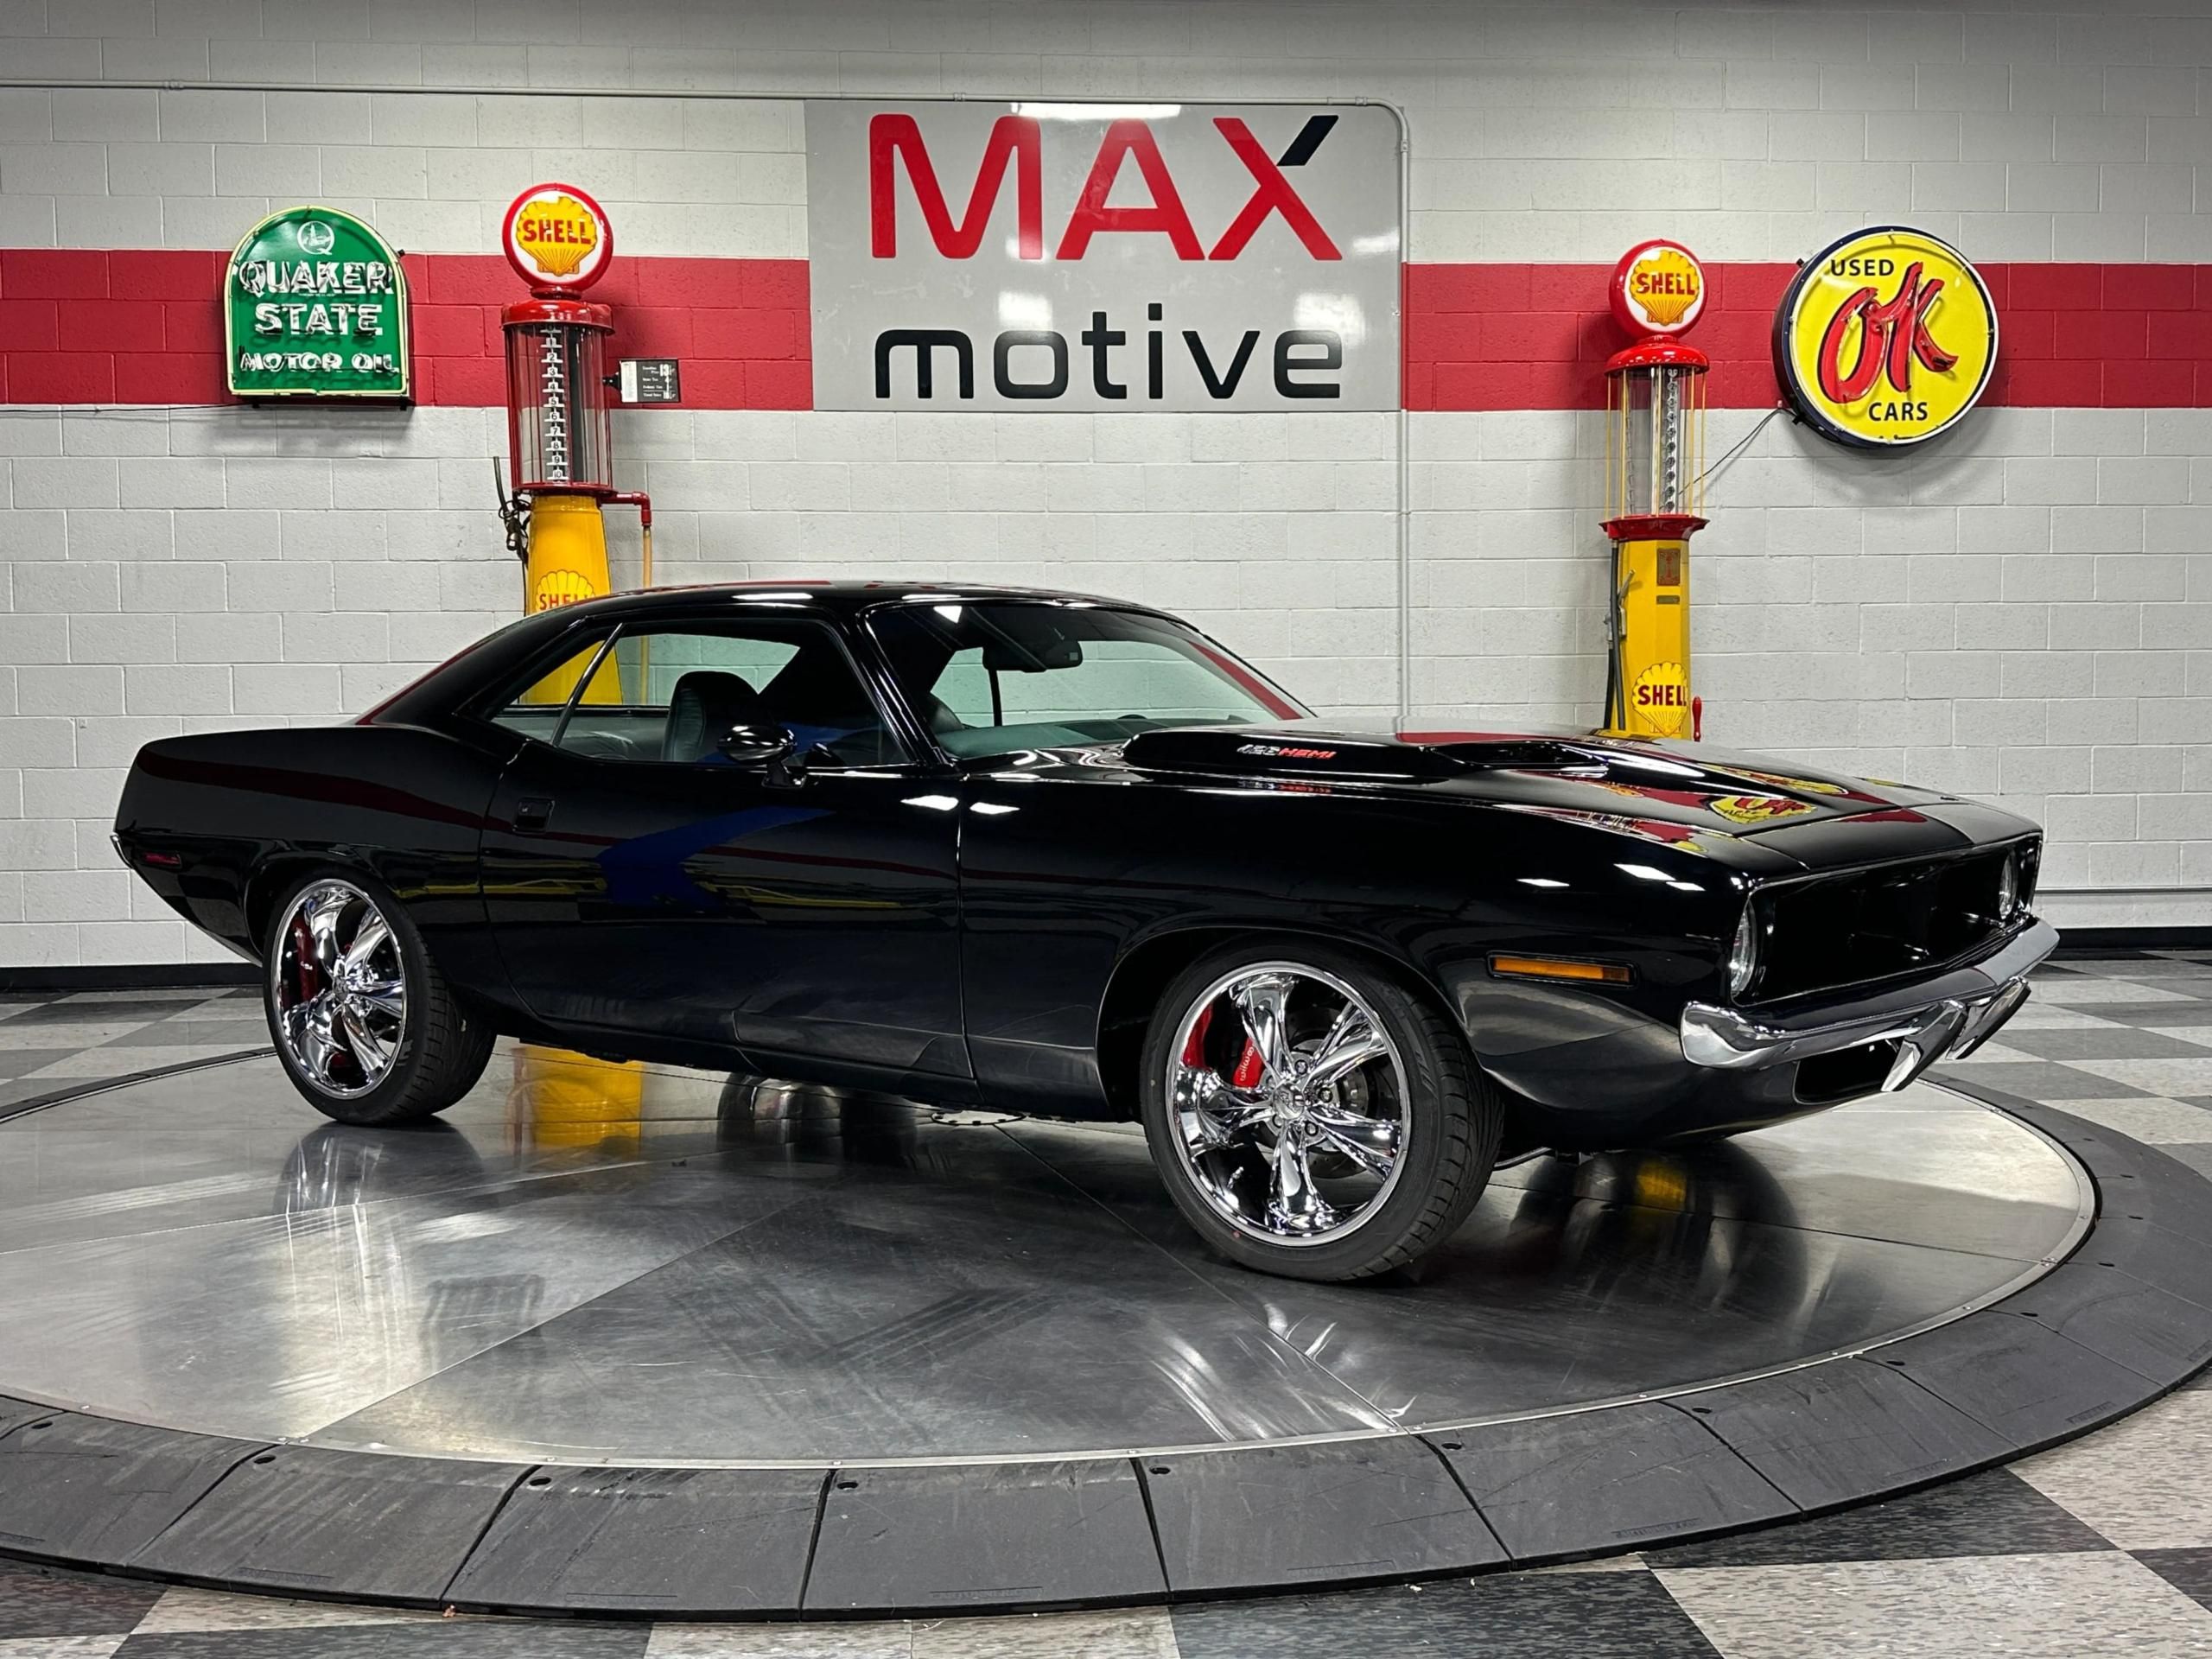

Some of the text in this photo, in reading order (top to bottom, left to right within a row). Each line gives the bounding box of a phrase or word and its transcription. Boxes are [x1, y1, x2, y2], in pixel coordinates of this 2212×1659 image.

[870, 113, 1343, 261] MAX
[523, 219, 592, 245] SHELL
[239, 260, 394, 297] QUAKER
[1830, 259, 1894, 276] USED
[1636, 272, 1695, 296] SHELL
[255, 302, 383, 336] STATE
[240, 353, 399, 372] MOTOR OIL
[874, 303, 1343, 399] motive
[1868, 402, 1928, 422] CARS
[1637, 684, 1687, 707] SHELL
